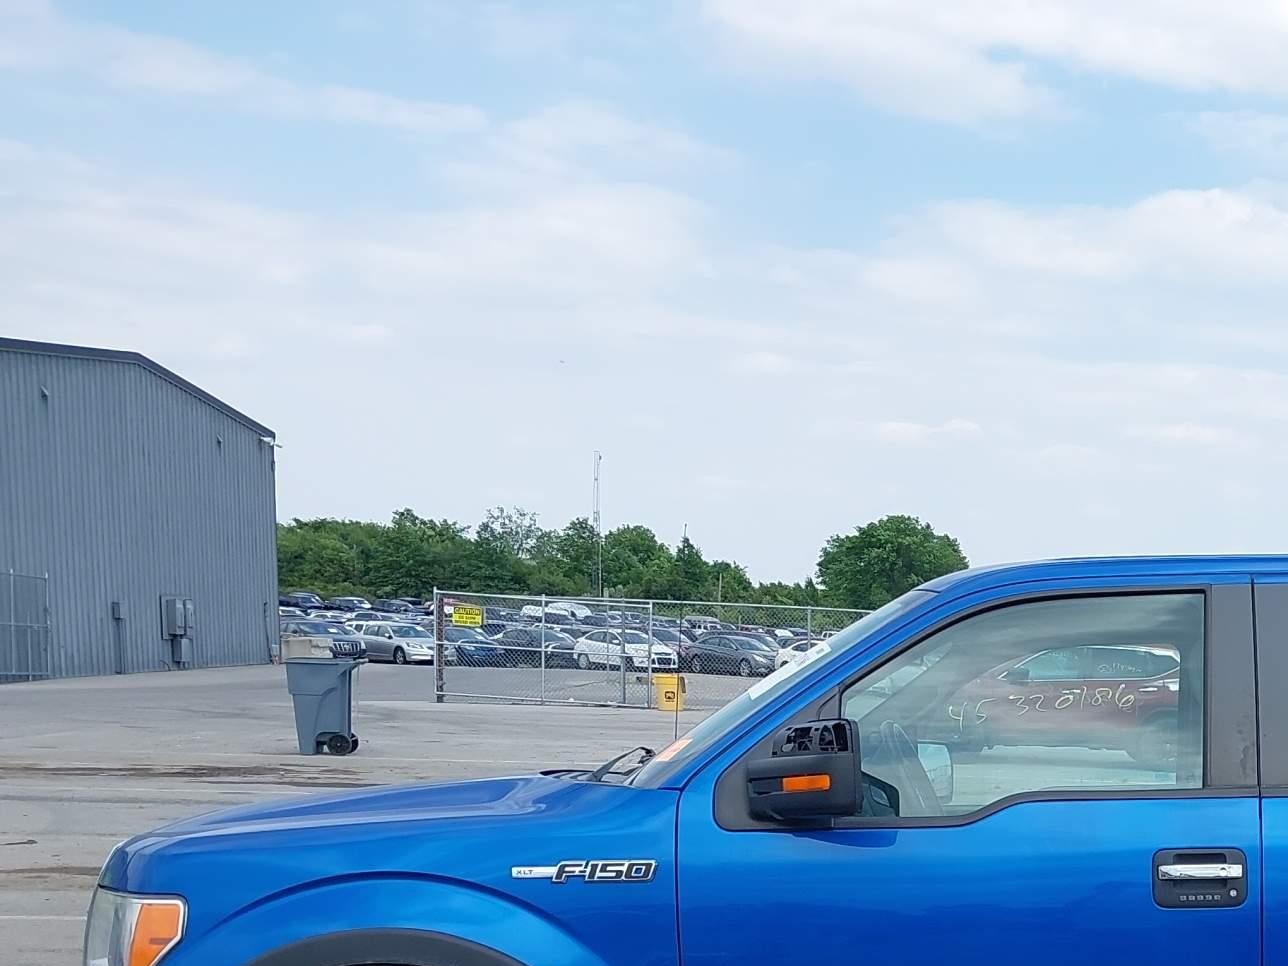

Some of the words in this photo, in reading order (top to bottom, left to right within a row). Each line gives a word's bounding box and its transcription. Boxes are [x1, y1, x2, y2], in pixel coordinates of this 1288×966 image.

[454, 607, 480, 616] CAUTION
[515, 868, 534, 876] XLT
[552, 859, 657, 883] F-150
